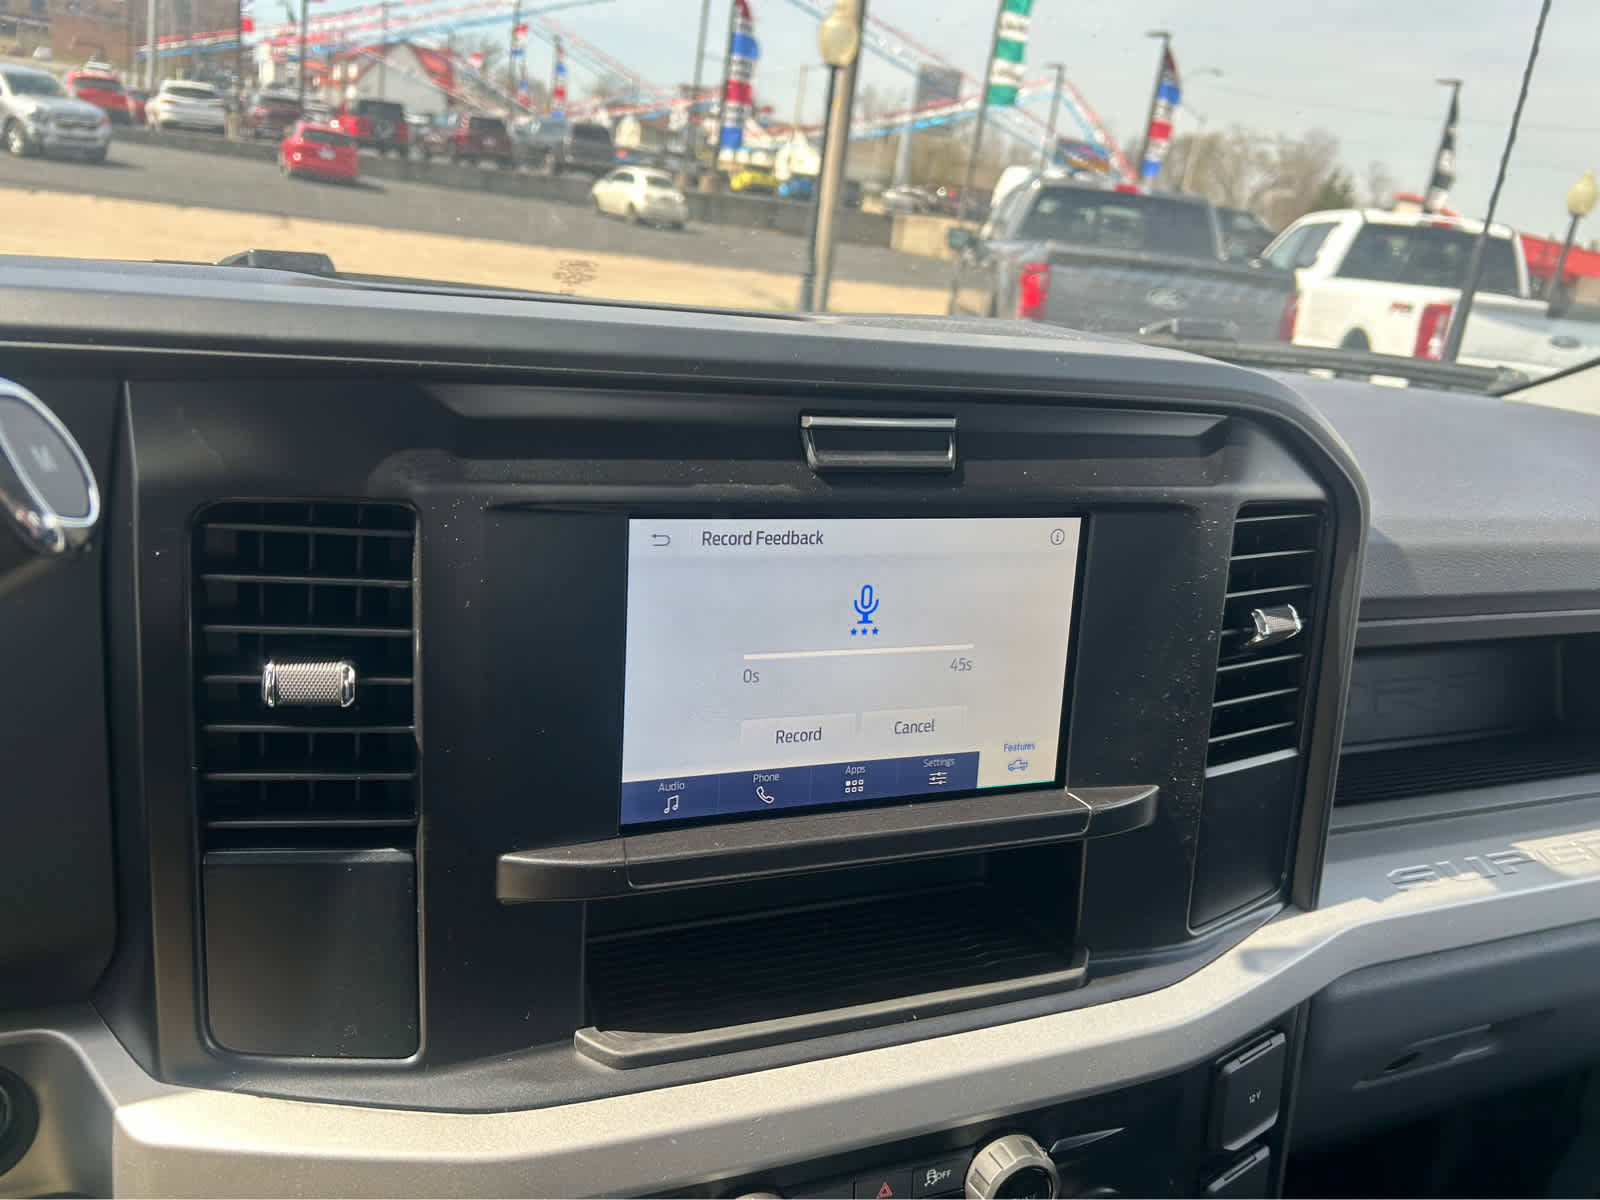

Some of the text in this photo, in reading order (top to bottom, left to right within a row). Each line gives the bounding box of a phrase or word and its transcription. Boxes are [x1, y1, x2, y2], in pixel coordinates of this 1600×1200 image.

[701, 529, 824, 546] Record Feedback
[950, 657, 972, 671] 45s
[743, 669, 760, 683] 0s
[894, 719, 935, 735] Cancel
[776, 726, 822, 743] Record
[1003, 742, 1036, 753] Features
[923, 757, 955, 769] Settings
[753, 770, 780, 782] Phone
[845, 765, 866, 777] Apps
[658, 780, 685, 792] Audio
[1386, 838, 1600, 892] SUPE
[936, 1169, 952, 1180] OFF
